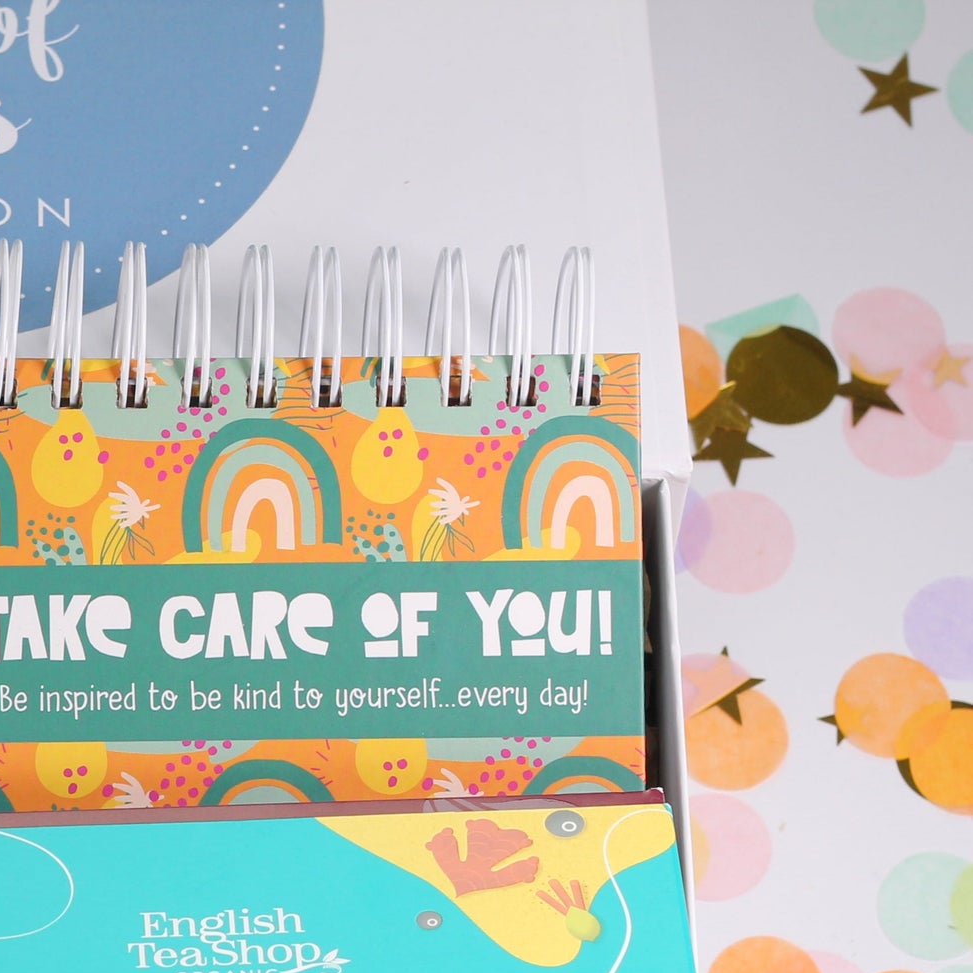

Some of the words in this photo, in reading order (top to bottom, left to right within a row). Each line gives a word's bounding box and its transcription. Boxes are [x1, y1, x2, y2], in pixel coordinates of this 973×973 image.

[361, 591, 438, 658] OF
[466, 590, 613, 657] YOU!
[39, 683, 136, 720] inspired
[149, 684, 178, 712] to
[190, 681, 221, 711] be
[233, 680, 281, 711] kind
[293, 682, 323, 710] to
[539, 680, 588, 712] day!
[139, 907, 305, 943] English
[128, 943, 207, 968] Tea
[212, 939, 323, 973] Shop
